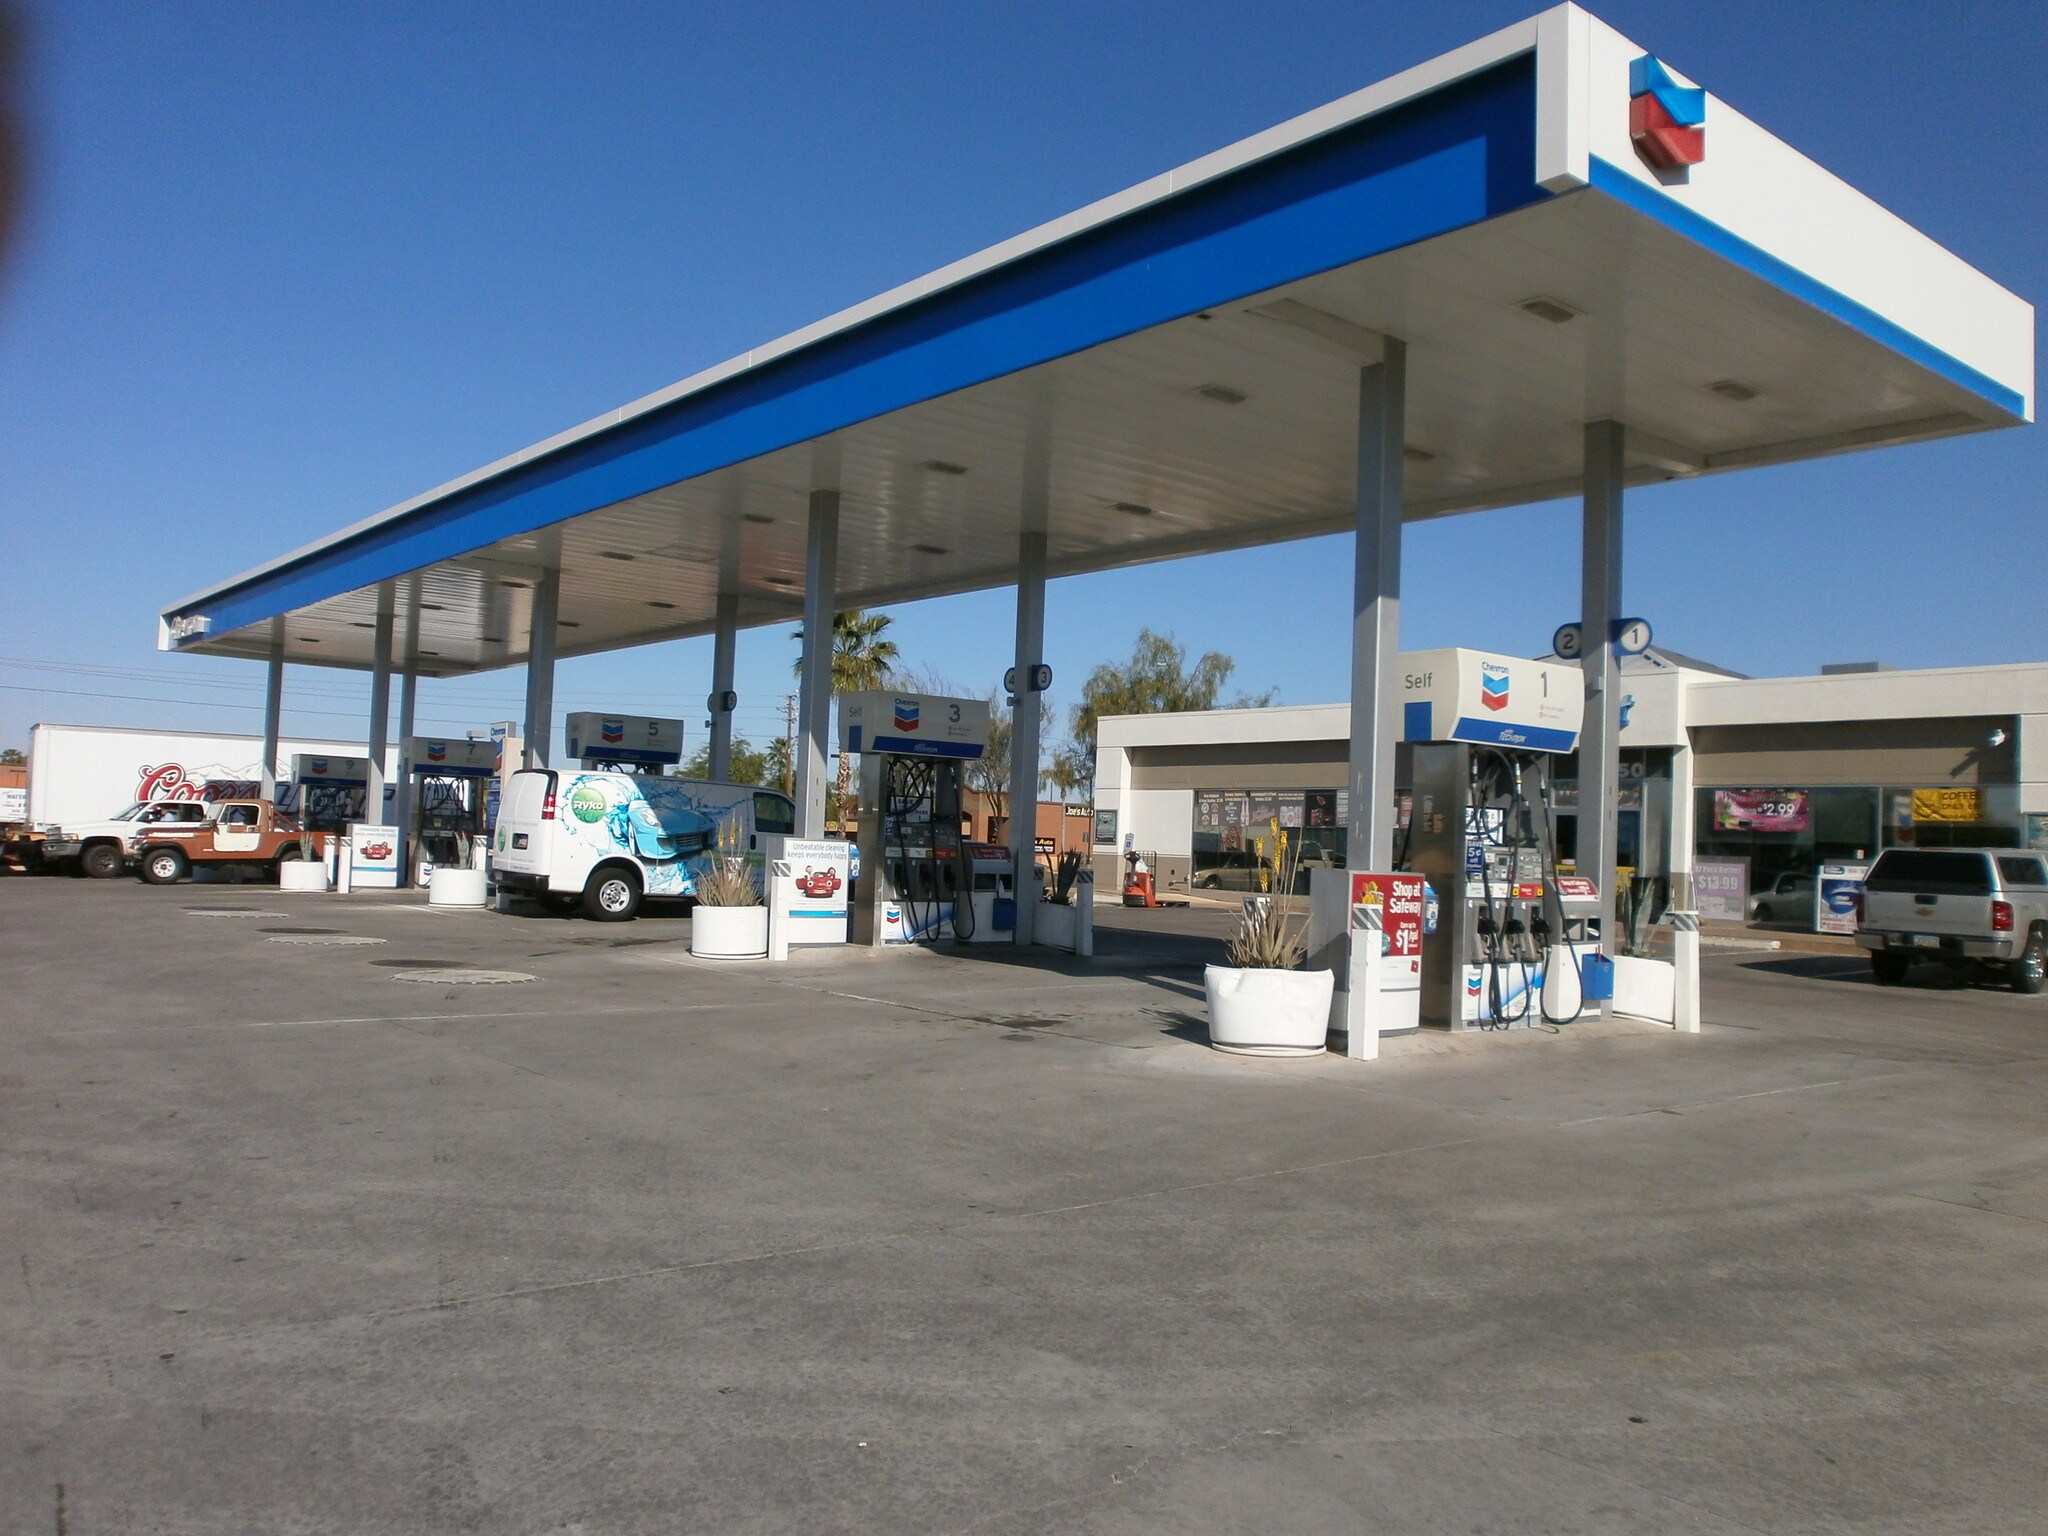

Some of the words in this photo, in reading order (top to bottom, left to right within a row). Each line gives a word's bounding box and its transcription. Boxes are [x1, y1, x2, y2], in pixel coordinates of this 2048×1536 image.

[1563, 633, 1574, 650] 2
[1632, 628, 1639, 645] 1
[1481, 661, 1509, 675] Chevron
[1041, 671, 1048, 684] 3
[1404, 672, 1433, 690] Self
[1540, 671, 1548, 698] 1
[894, 698, 920, 707] Chevron
[848, 705, 863, 718] Self
[948, 704, 961, 723] 3
[648, 721, 659, 736] 5
[466, 743, 475, 755] 7
[345, 759, 354, 770] 9
[573, 800, 605, 811] Ryko
[1066, 806, 1081, 816] Joe's
[1763, 803, 1796, 818] $2.99
[1392, 880, 1411, 900] Shop
[1413, 882, 1421, 897] at
[1389, 897, 1422, 917] Safeway
[1396, 929, 1408, 955] $1
